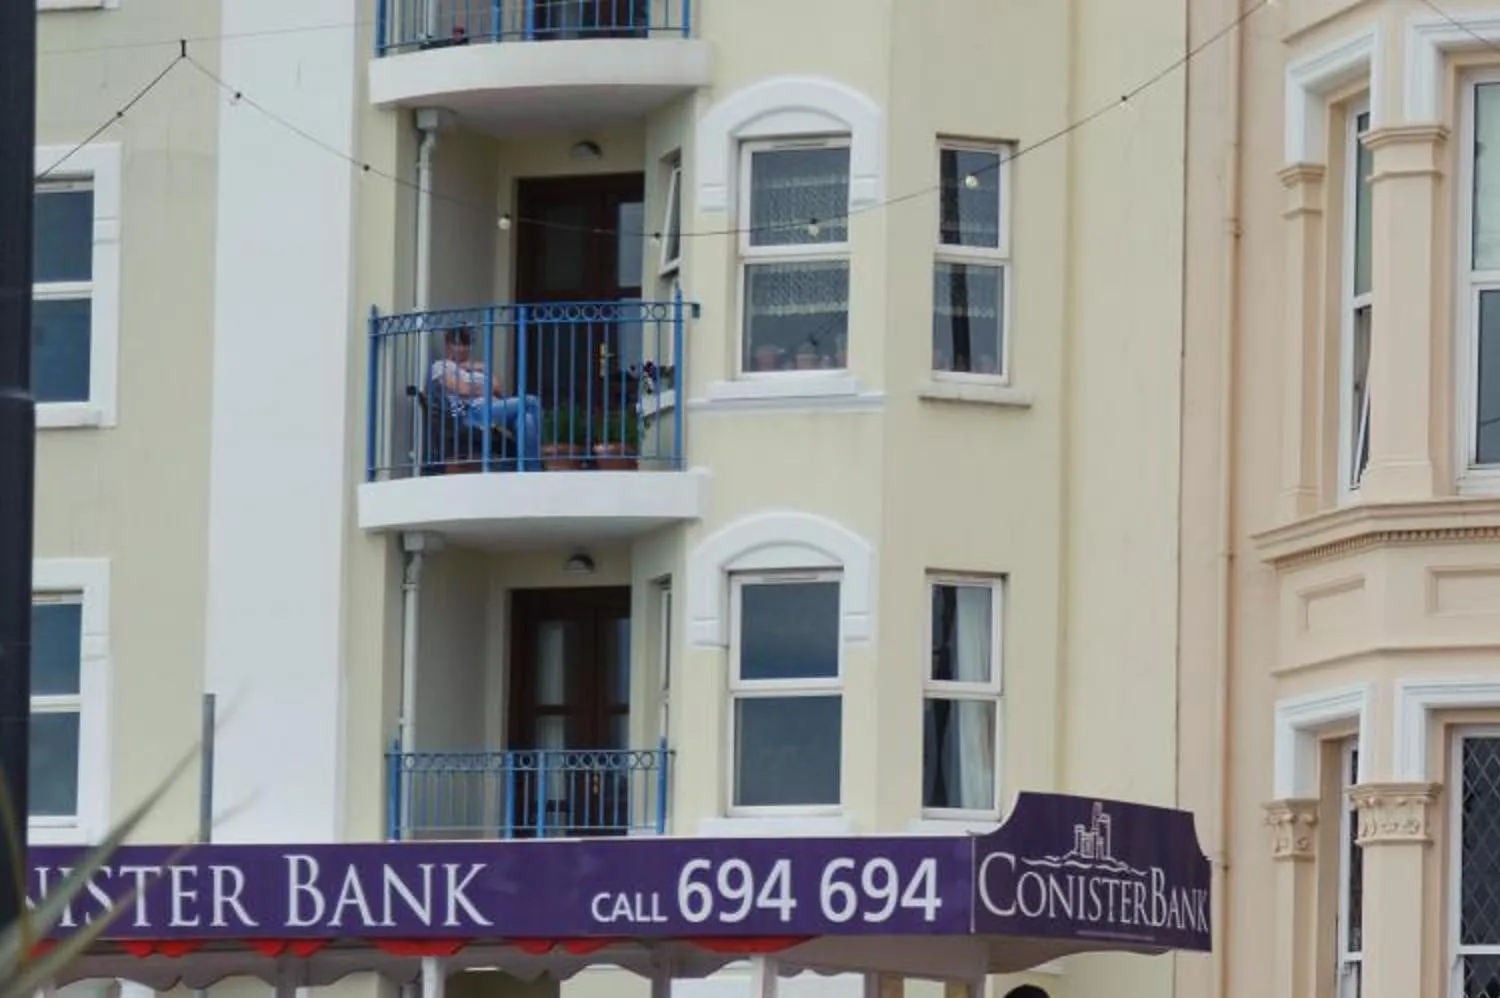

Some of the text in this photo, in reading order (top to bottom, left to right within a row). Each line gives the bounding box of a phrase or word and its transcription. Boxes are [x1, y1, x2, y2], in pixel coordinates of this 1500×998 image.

[283, 855, 494, 927] BANK
[591, 857, 942, 923] CALL 694 694
